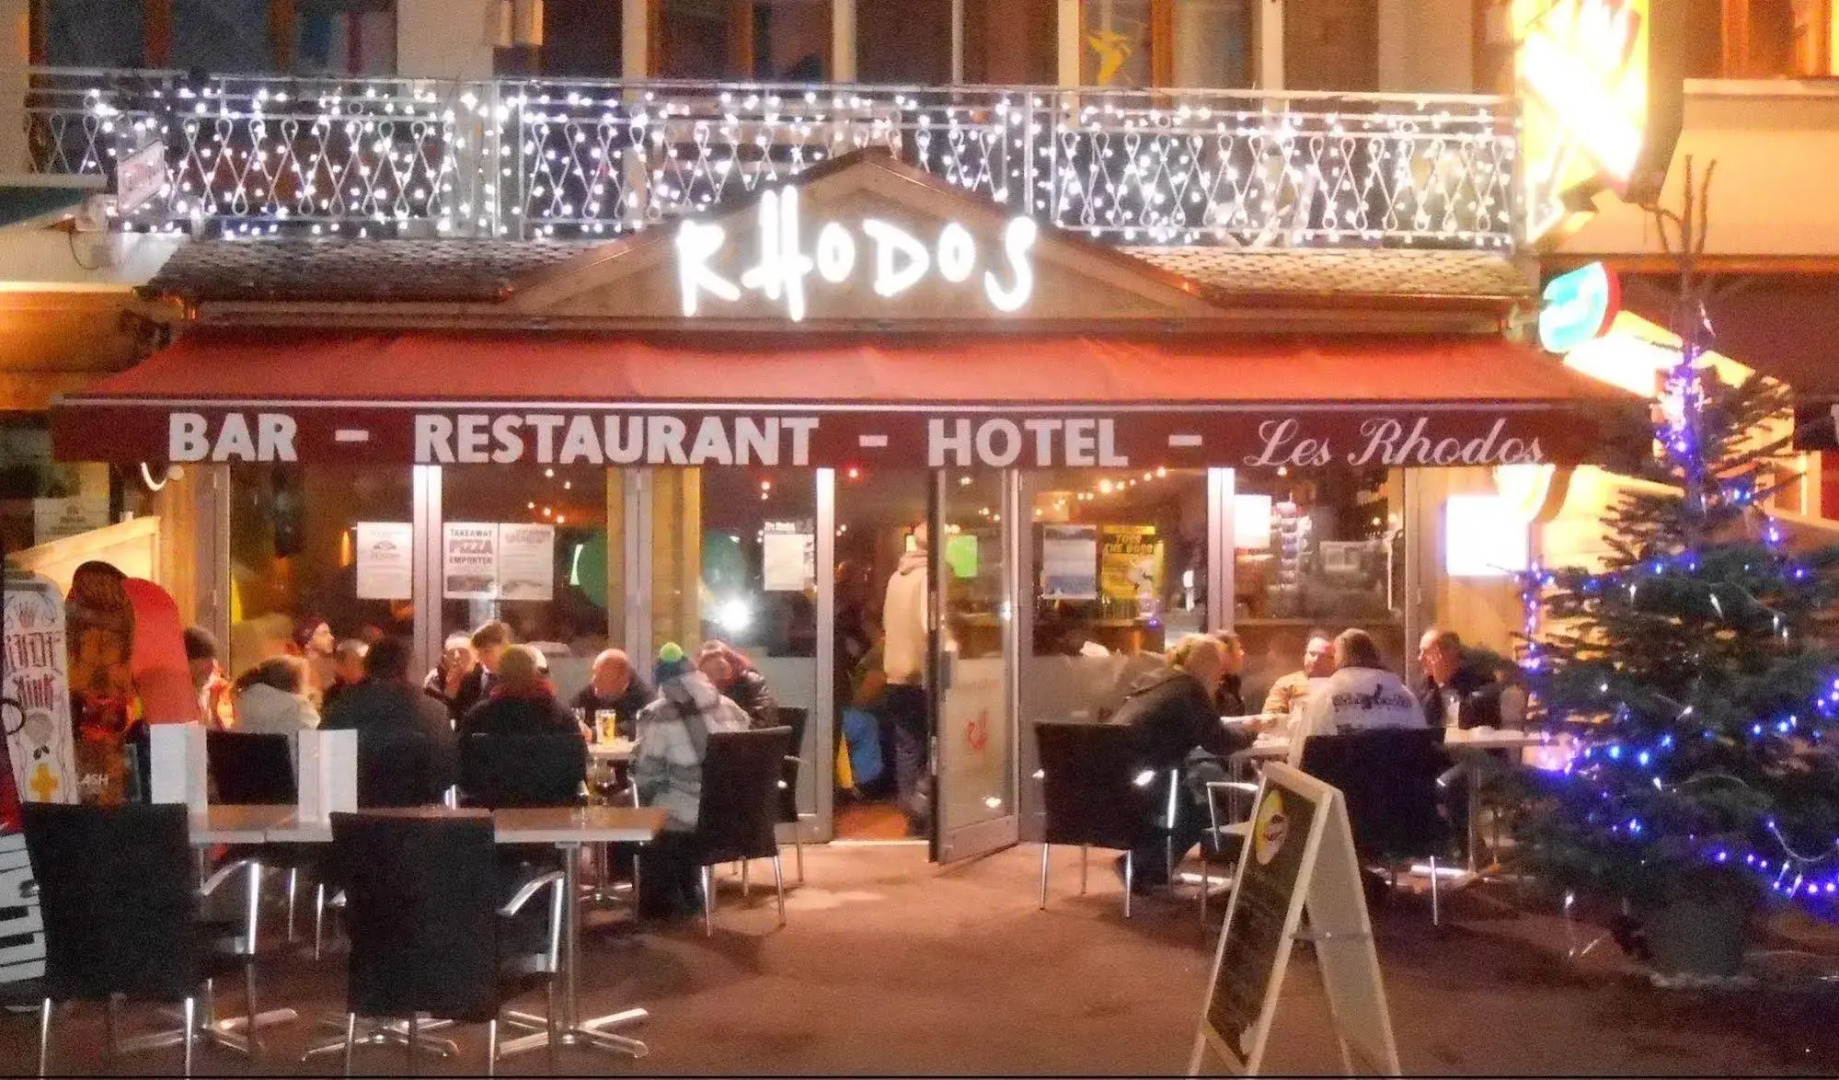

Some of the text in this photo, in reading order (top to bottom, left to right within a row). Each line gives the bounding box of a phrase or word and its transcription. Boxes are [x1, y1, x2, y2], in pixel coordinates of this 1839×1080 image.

[675, 184, 1038, 322] RHODOS
[169, 412, 298, 462] BAR
[415, 414, 819, 466] RESTAURANT
[928, 418, 1129, 467] HOTEL
[1243, 418, 1332, 467] Les
[1347, 416, 1546, 466] Rhodos
[450, 529, 492, 537] TAKEAWAY
[449, 539, 493, 554] PIZZA
[450, 556, 492, 565] EMPORTER
